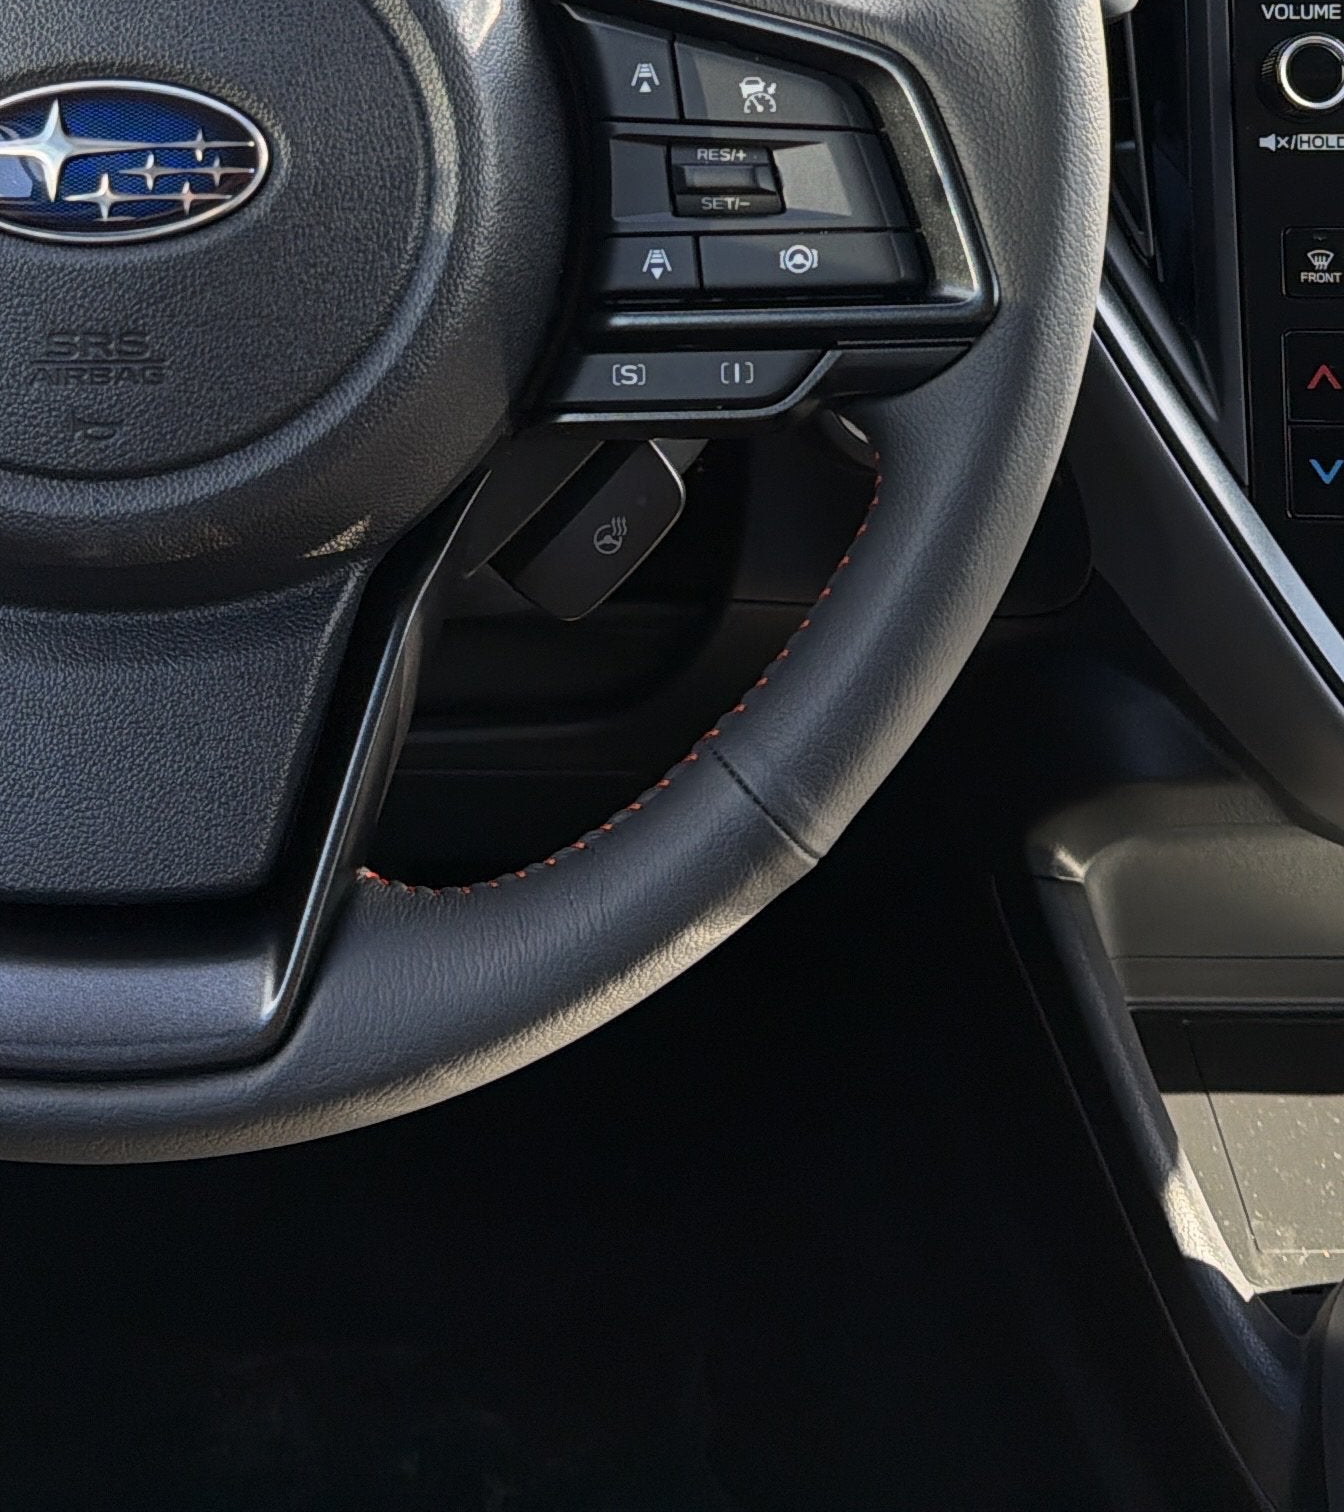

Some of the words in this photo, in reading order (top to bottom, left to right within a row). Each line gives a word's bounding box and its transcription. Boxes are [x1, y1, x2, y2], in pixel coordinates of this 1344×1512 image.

[1260, 3, 1342, 20] VOLUME
[1300, 271, 1343, 284] FRONT
[47, 333, 152, 360] SRS
[29, 366, 168, 386] AIRBAG
